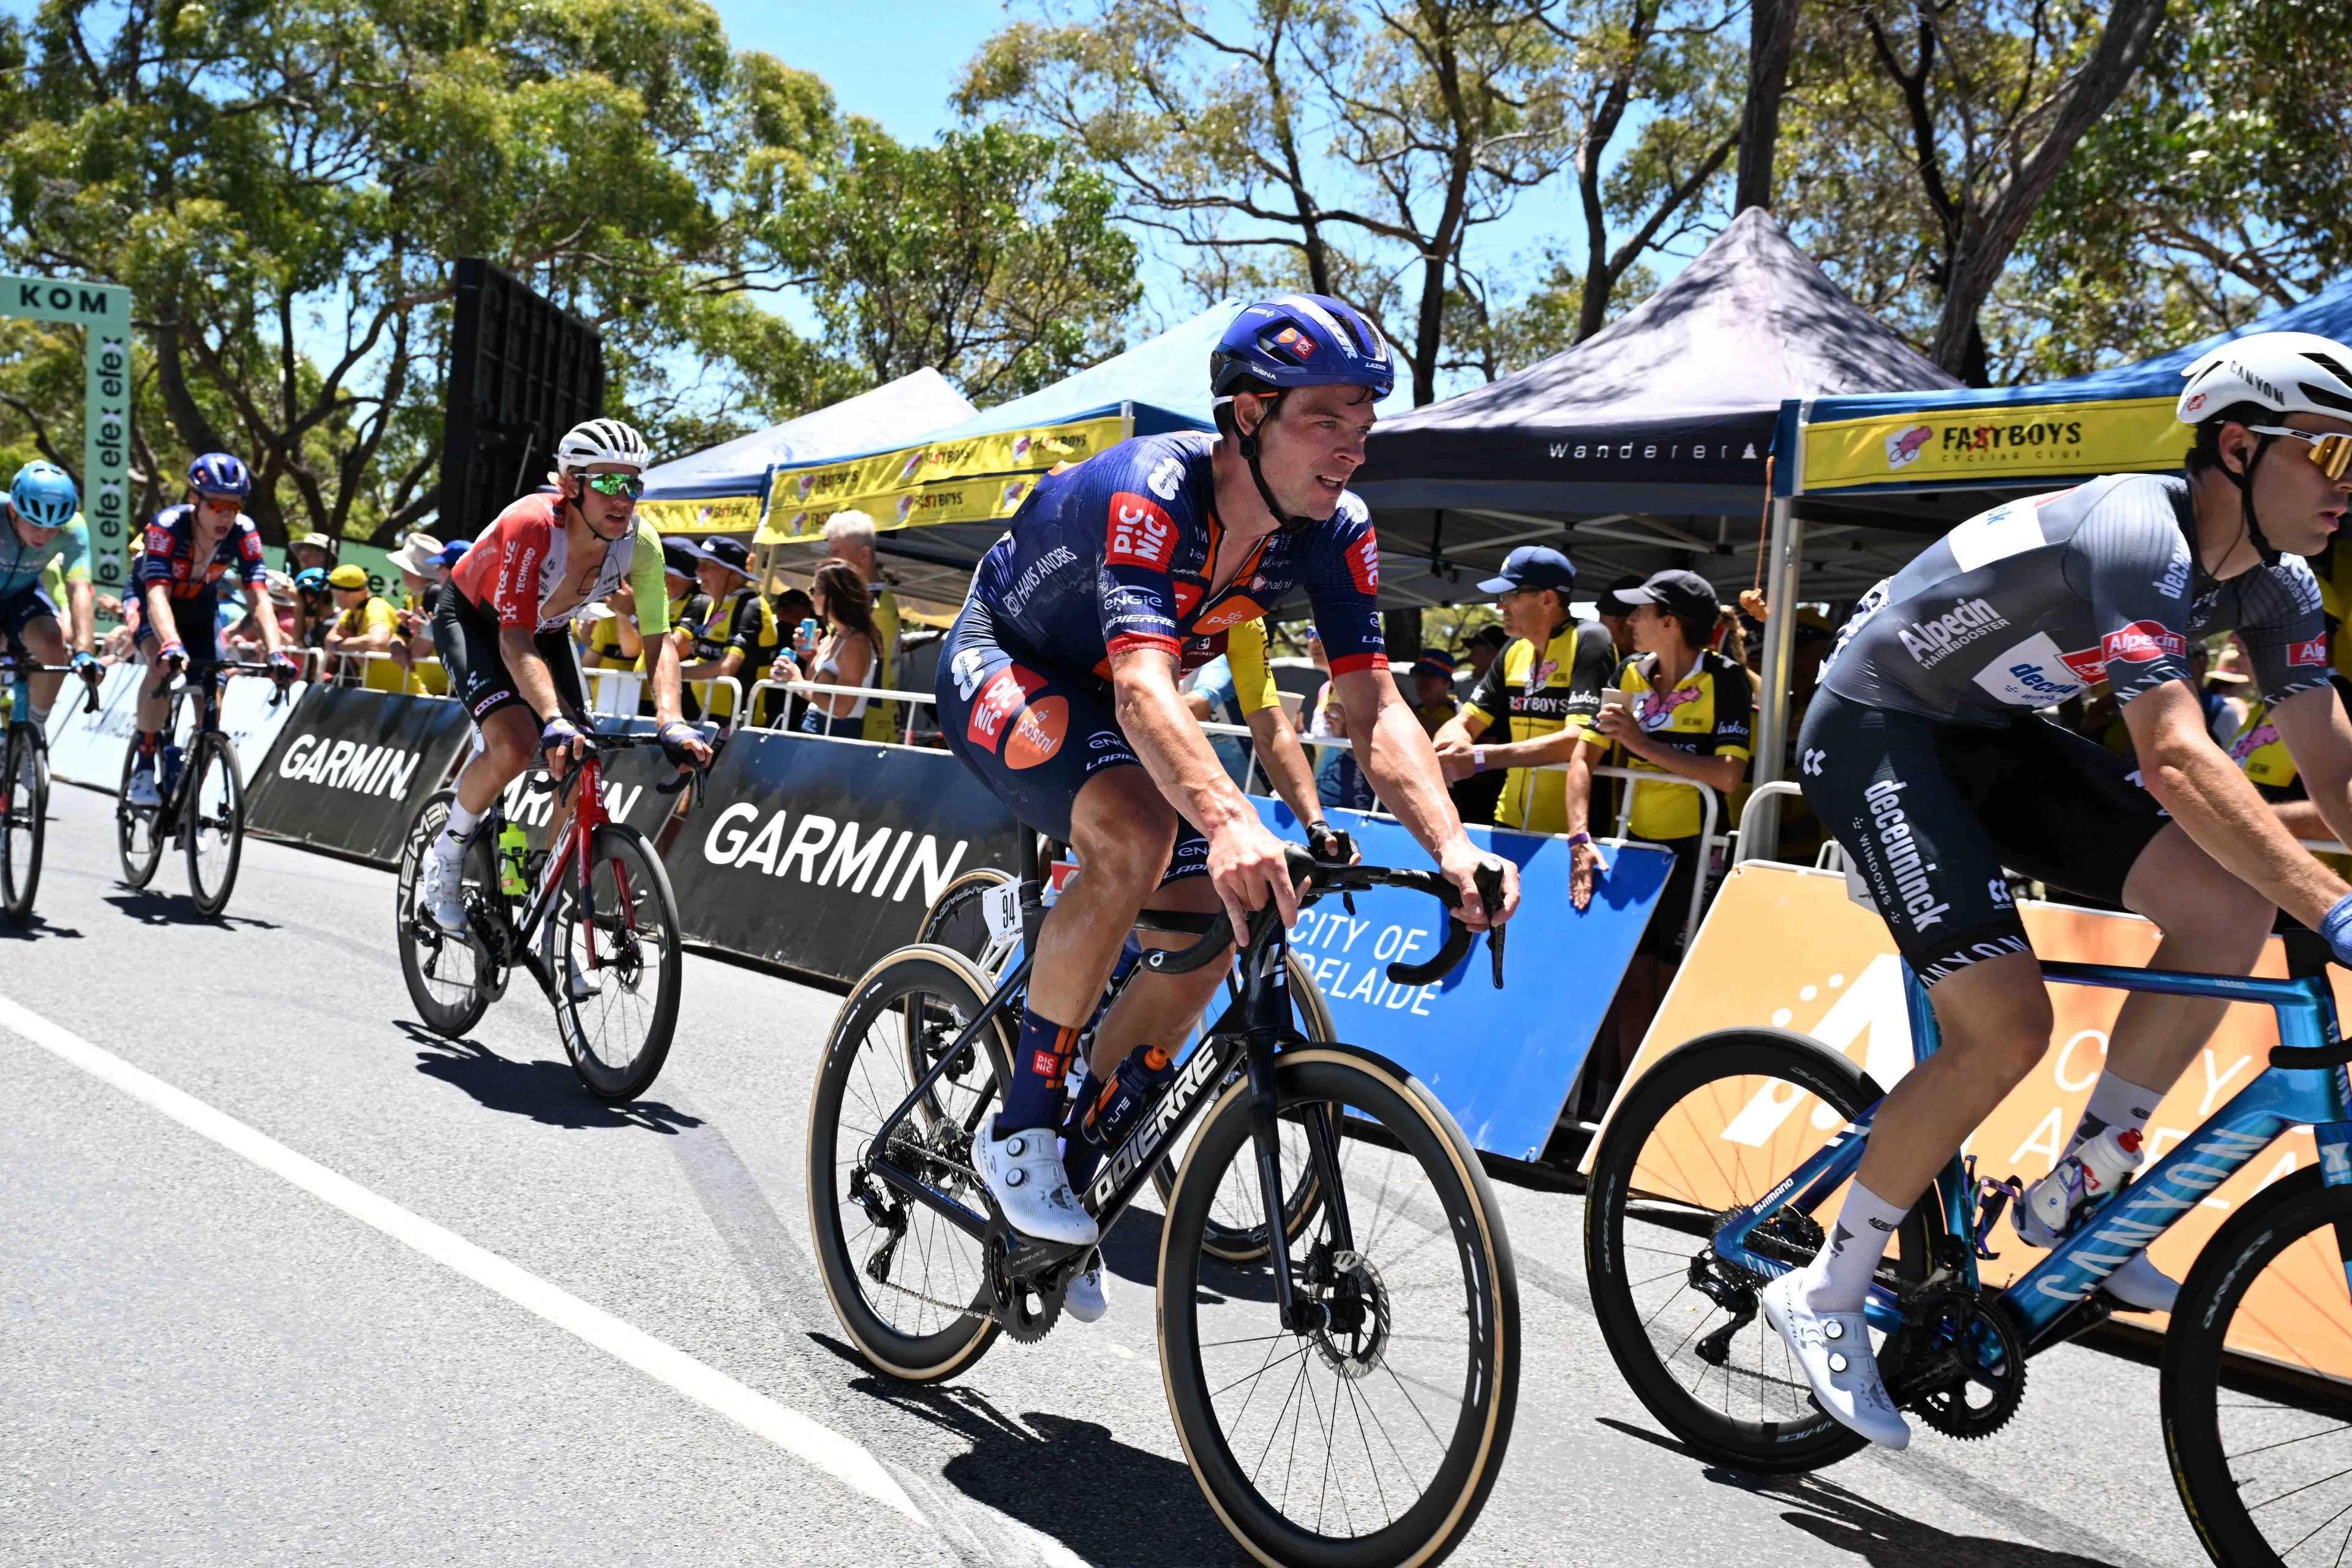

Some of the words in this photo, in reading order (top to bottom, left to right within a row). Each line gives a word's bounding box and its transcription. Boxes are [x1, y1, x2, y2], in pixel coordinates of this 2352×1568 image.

[20, 284, 107, 314] KOM
[96, 336, 123, 397] efex
[1252, 366, 1276, 380] SENA
[1365, 362, 1387, 371] LAZER
[2230, 360, 2285, 405] CANYON
[95, 407, 122, 468] efex
[1550, 442, 1728, 460] Wanderer
[1942, 452, 2019, 463] CYCLING
[94, 477, 121, 538] efex
[1114, 505, 1144, 554] PIC
[1134, 513, 1167, 561] NiC
[1014, 566, 1040, 606] HANS
[1036, 545, 1078, 579] ANDERS
[1102, 614, 1176, 635] LAPIERRE
[1898, 598, 2002, 663] Alpecin
[1921, 646, 1948, 669] HAIR
[1951, 618, 2011, 649] BOOSTER
[2109, 633, 2179, 653] Alpecin
[974, 703, 1001, 736] NiC
[1017, 718, 1057, 754] postnl
[279, 733, 420, 801] GARMIN
[593, 764, 603, 807] CUBE
[519, 822, 571, 931] CUBE
[704, 802, 968, 908] GARMIN
[1859, 833, 1892, 906] WINDOWS
[1864, 779, 1950, 933] deceuninck
[1003, 892, 1016, 929] 94
[1287, 908, 1370, 956] CITY
[1373, 924, 1428, 962] OF
[1298, 952, 1444, 1016] DELAIDE
[1095, 1038, 1218, 1212] APIERRE
[1752, 1177, 1795, 1216] SHIMANO
[2035, 1128, 2272, 1301] CANYON
